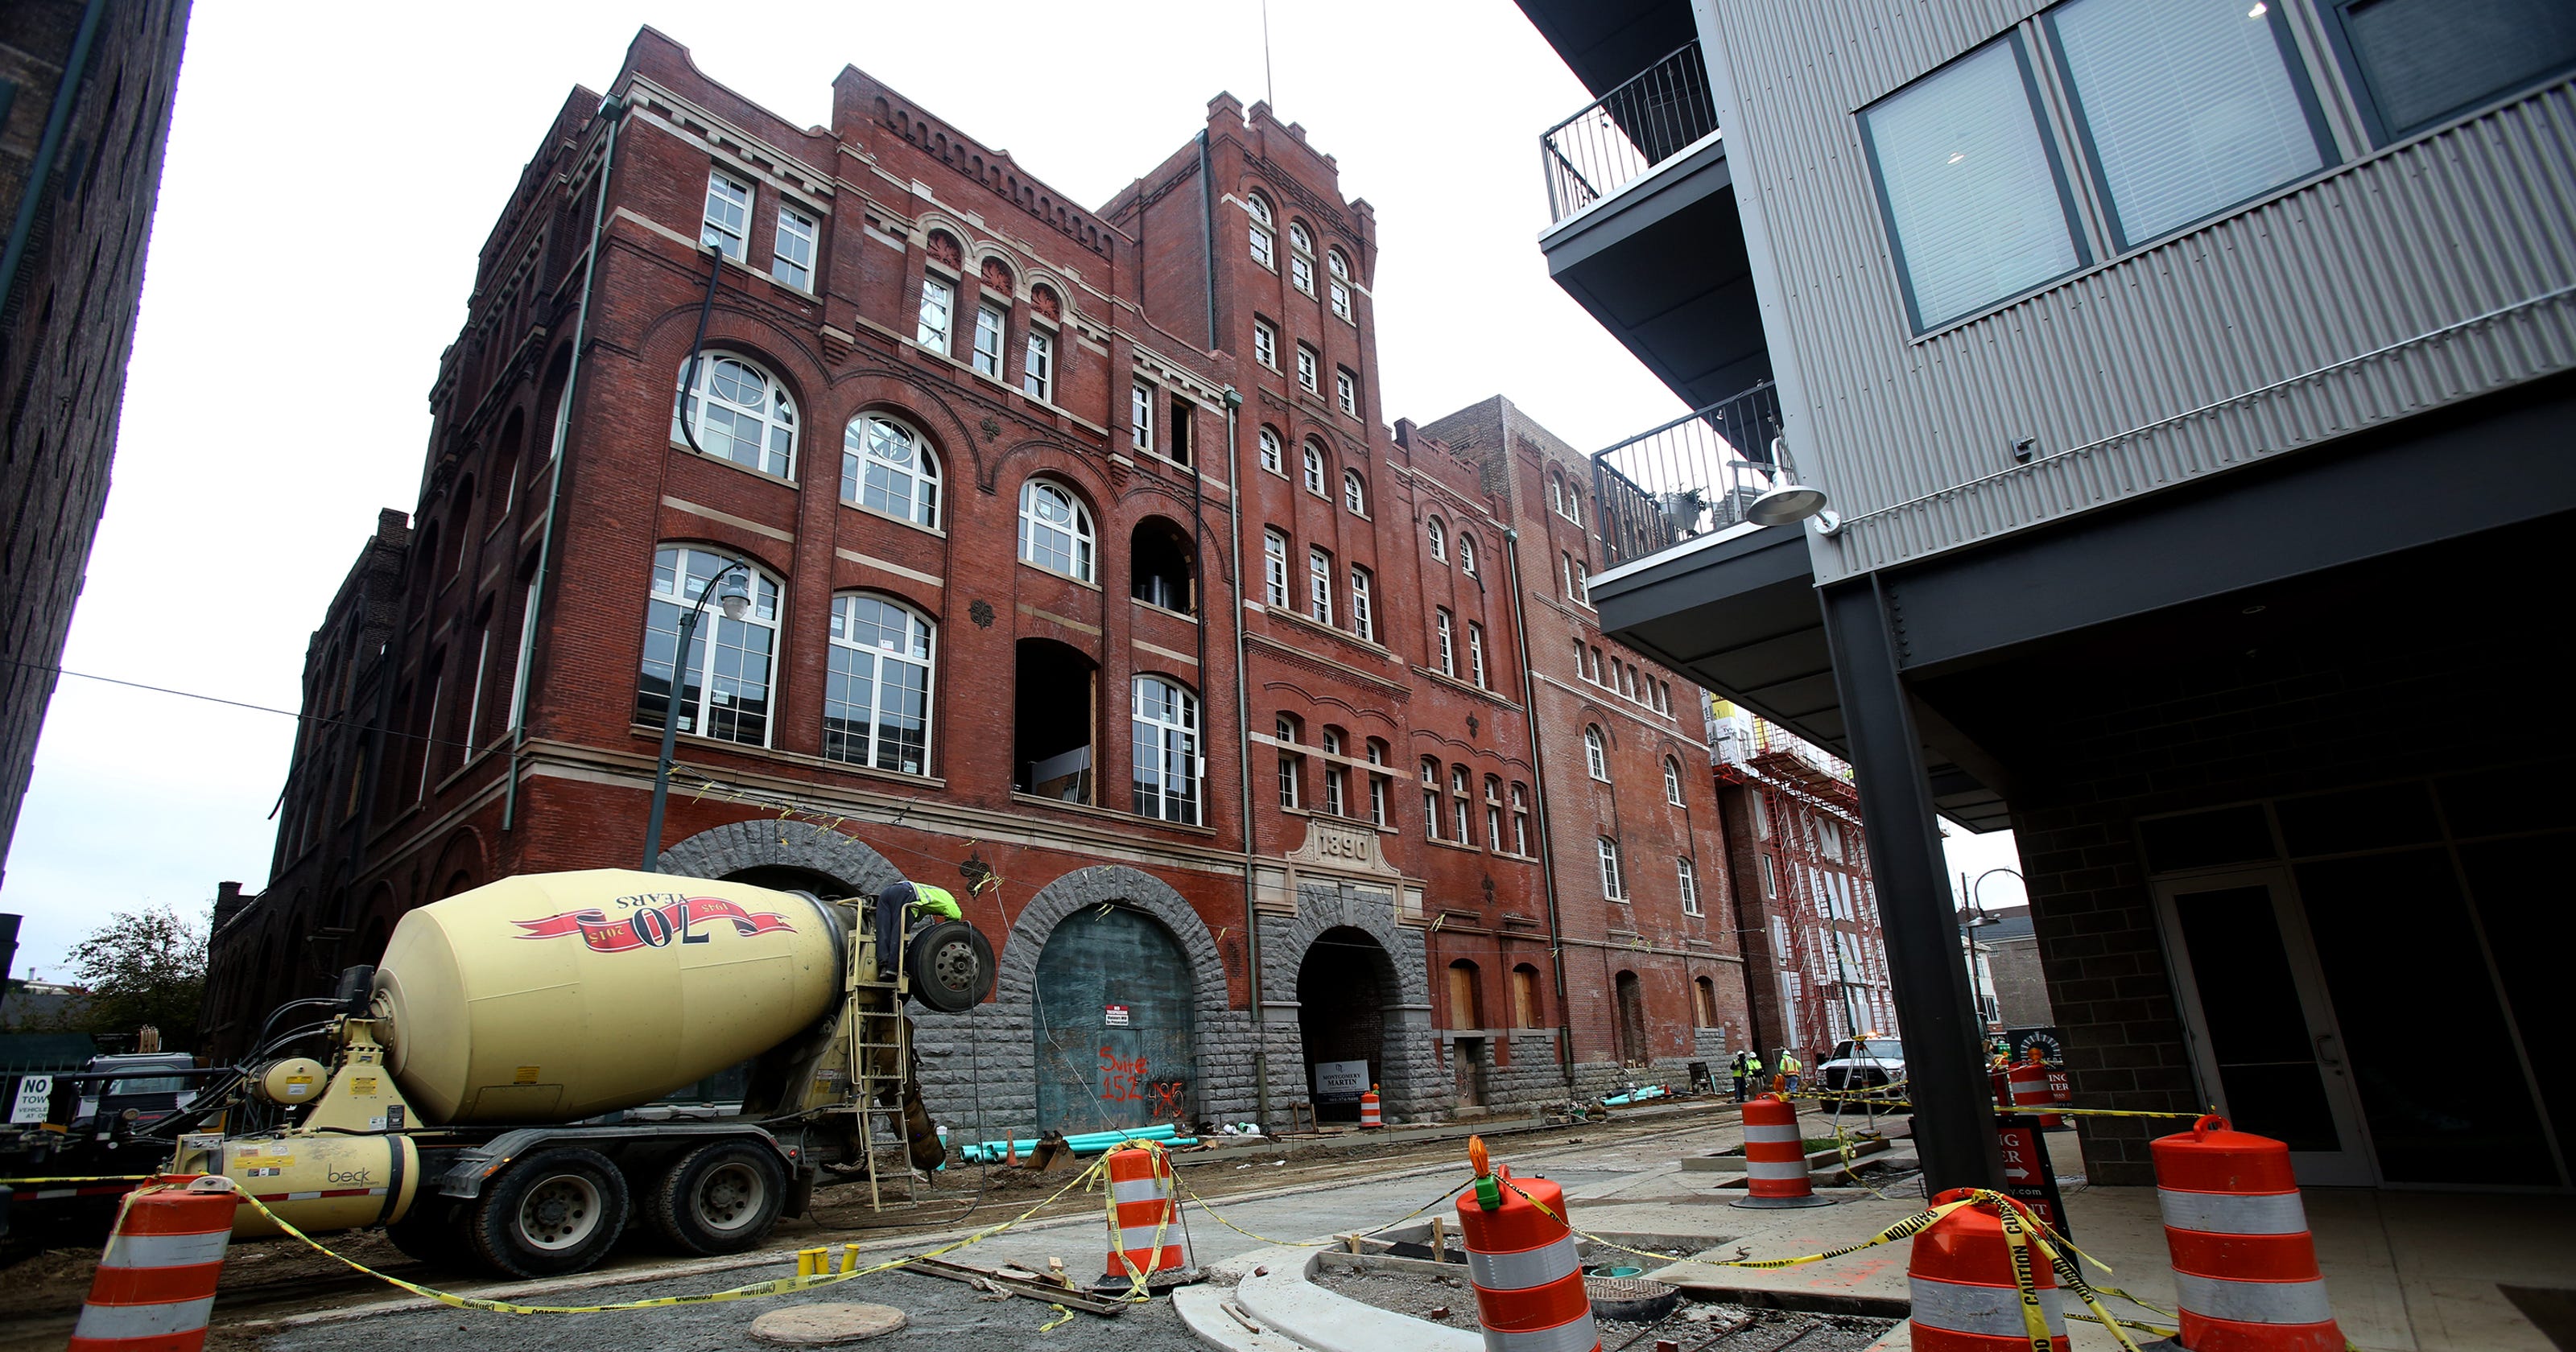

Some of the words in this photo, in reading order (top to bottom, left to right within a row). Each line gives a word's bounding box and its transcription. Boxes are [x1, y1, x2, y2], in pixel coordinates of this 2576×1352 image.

[1320, 834, 1368, 860] 1890
[616, 892, 690, 909] YEARS
[701, 901, 730, 913] 1945
[588, 925, 625, 944] 2015
[632, 904, 710, 948] 70
[1099, 1046, 1148, 1074] Suite
[24, 1078, 47, 1093] NO
[1100, 1075, 1144, 1103] 152
[1327, 1078, 1357, 1086] MARTIN
[23, 1095, 47, 1104] TOW
[328, 1163, 371, 1187] beck
[2012, 1245, 2039, 1306] CAUTION
